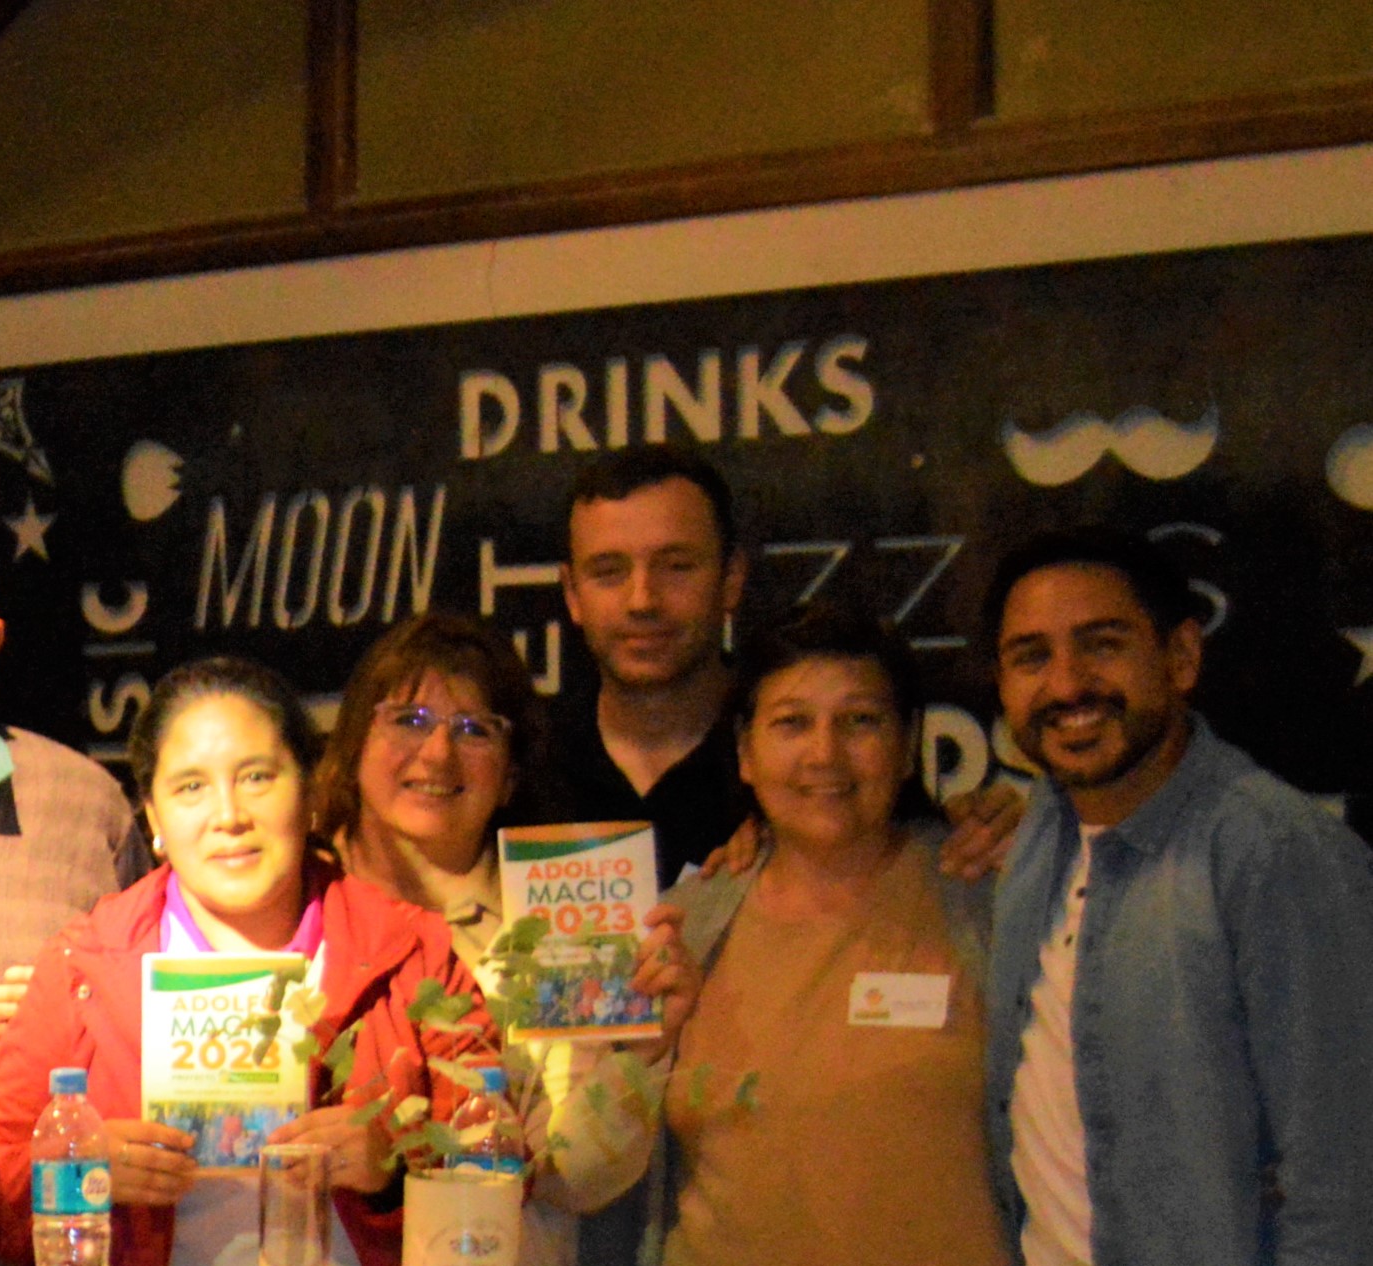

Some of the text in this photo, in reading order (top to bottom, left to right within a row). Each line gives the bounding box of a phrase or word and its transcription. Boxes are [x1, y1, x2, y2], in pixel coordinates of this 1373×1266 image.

[459, 333, 877, 460] DRINKS
[194, 483, 447, 630] MOON
[722, 534, 969, 652] ZZ
[80, 580, 158, 764] SIC
[526, 857, 633, 880] ADOLFO
[527, 878, 634, 904] MACIO
[171, 1015, 267, 1038] MACI
